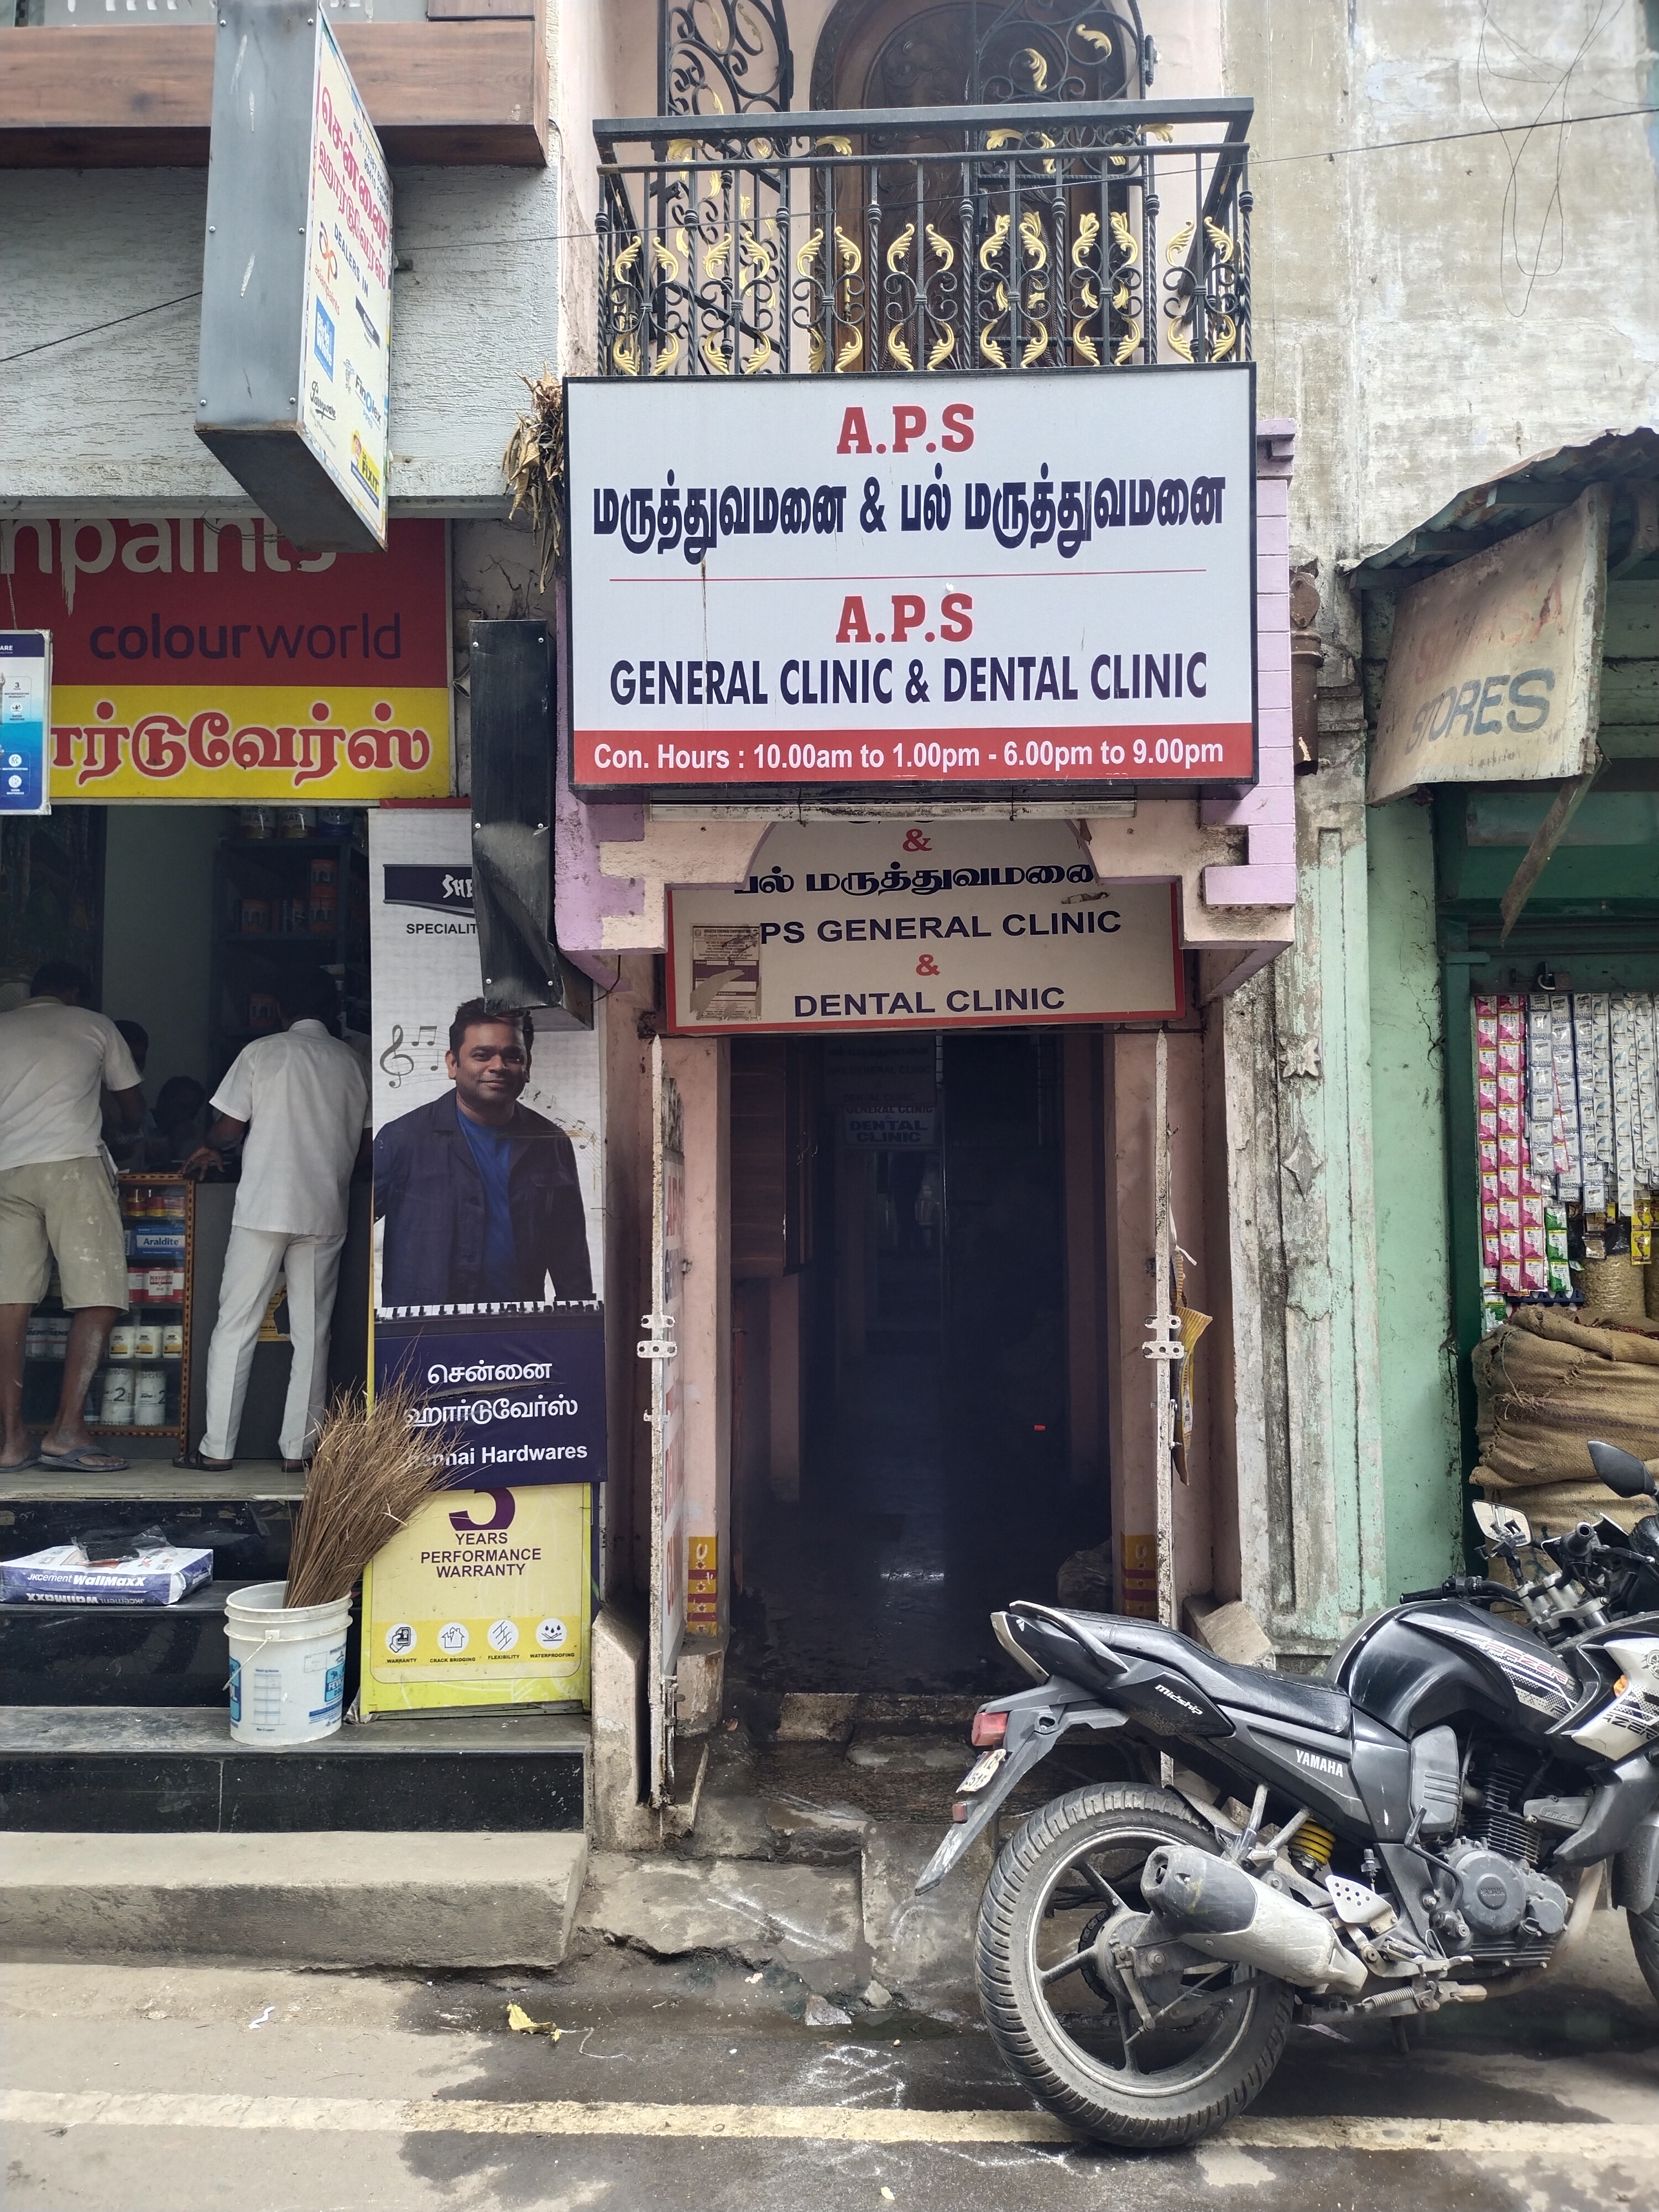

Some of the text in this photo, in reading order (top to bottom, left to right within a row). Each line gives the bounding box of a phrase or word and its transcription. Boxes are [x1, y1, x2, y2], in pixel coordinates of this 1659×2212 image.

[322, 86, 387, 249] சென்னை
[335, 222, 368, 298] DEALERS IN
[315, 264, 340, 316] asianpaints
[317, 311, 329, 346] Birla
[316, 335, 332, 367] White
[837, 403, 975, 455] A.P.S
[362, 461, 379, 493] FIXIT
[593, 462, 1226, 565] மருத்துவமனை & பல் மருத்துவமனை
[836, 593, 974, 644] A.P.S
[611, 651, 1207, 705] GENERAL CLINIC & DENTAL CLINIC
[1405, 668, 1556, 756] STORES
[594, 743, 649, 769] Con.
[658, 743, 729, 770] Hours
[754, 743, 852, 769] 10.00am
[860, 744, 884, 769] to
[893, 742, 979, 775] 1.00pm
[1004, 742, 1092, 774] 6.00pm
[1100, 741, 1124, 766] to
[1133, 739, 1224, 772] 9.00pm
[902, 828, 932, 853] &
[760, 910, 1122, 945] PS GENERAL CLINIC
[916, 953, 941, 977] &
[795, 987, 1065, 1018] DENTAL CLINIC
[849, 1120, 928, 1131] DENTAL
[856, 1131, 921, 1143] CLINIC
[144, 1238, 179, 1246] Araldite
[428, 1359, 552, 1384] சென்னை
[113, 1387, 126, 1401] 2
[404, 1394, 578, 1427] ஹார்டுவேர்ஸ்
[482, 1444, 588, 1464] Hardwares
[455, 1532, 508, 1546] YEARS
[421, 1548, 541, 1564] PERFORMANCE
[436, 1563, 526, 1578] WARRANTY
[1484, 1641, 1569, 1685] FAZER
[1296, 1749, 1343, 1778] YAMAHA
[1480, 1886, 1505, 1897] YAMAHA
